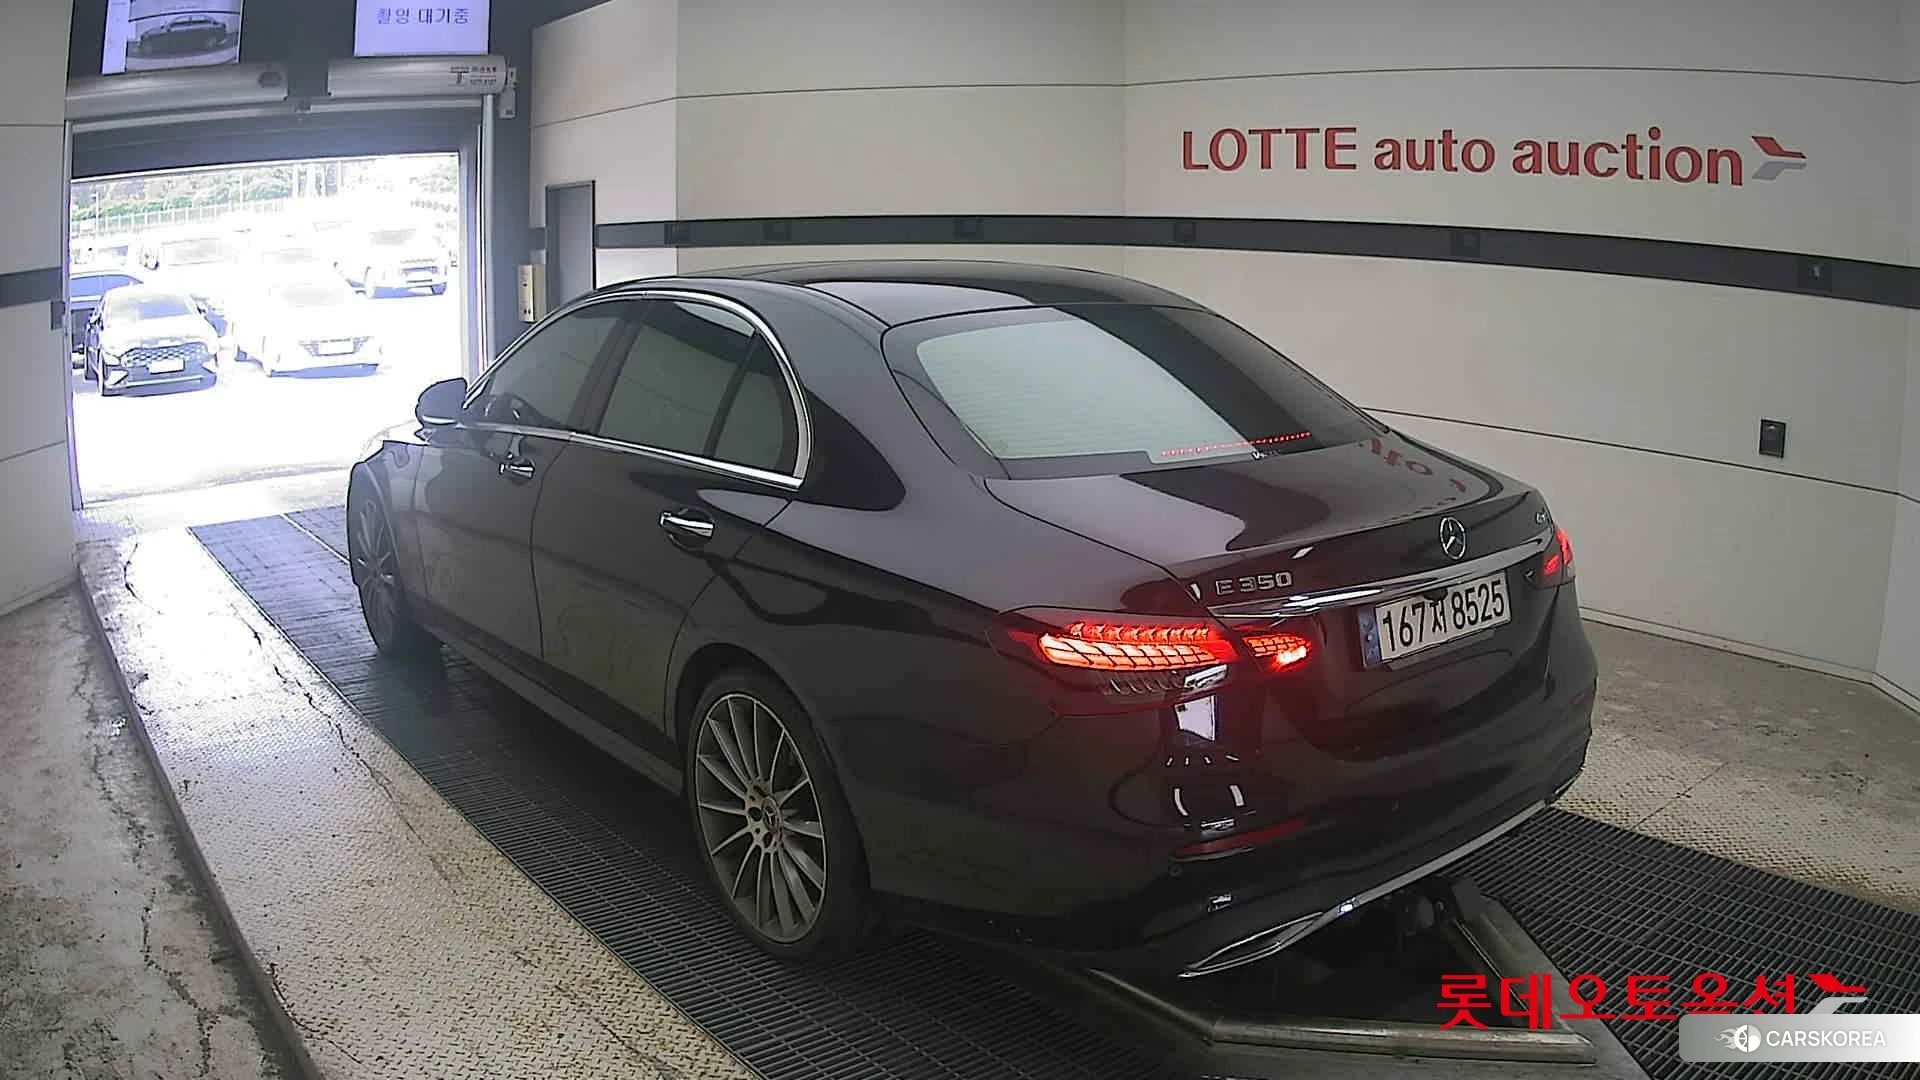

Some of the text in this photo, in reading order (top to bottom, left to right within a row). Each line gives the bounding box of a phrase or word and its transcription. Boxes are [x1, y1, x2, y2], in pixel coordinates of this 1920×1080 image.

[418, 7, 469, 25] 대기중
[1182, 125, 1745, 187] LOTTE auto auction
[1215, 571, 1293, 596] E 350
[1451, 579, 1505, 630] 8525
